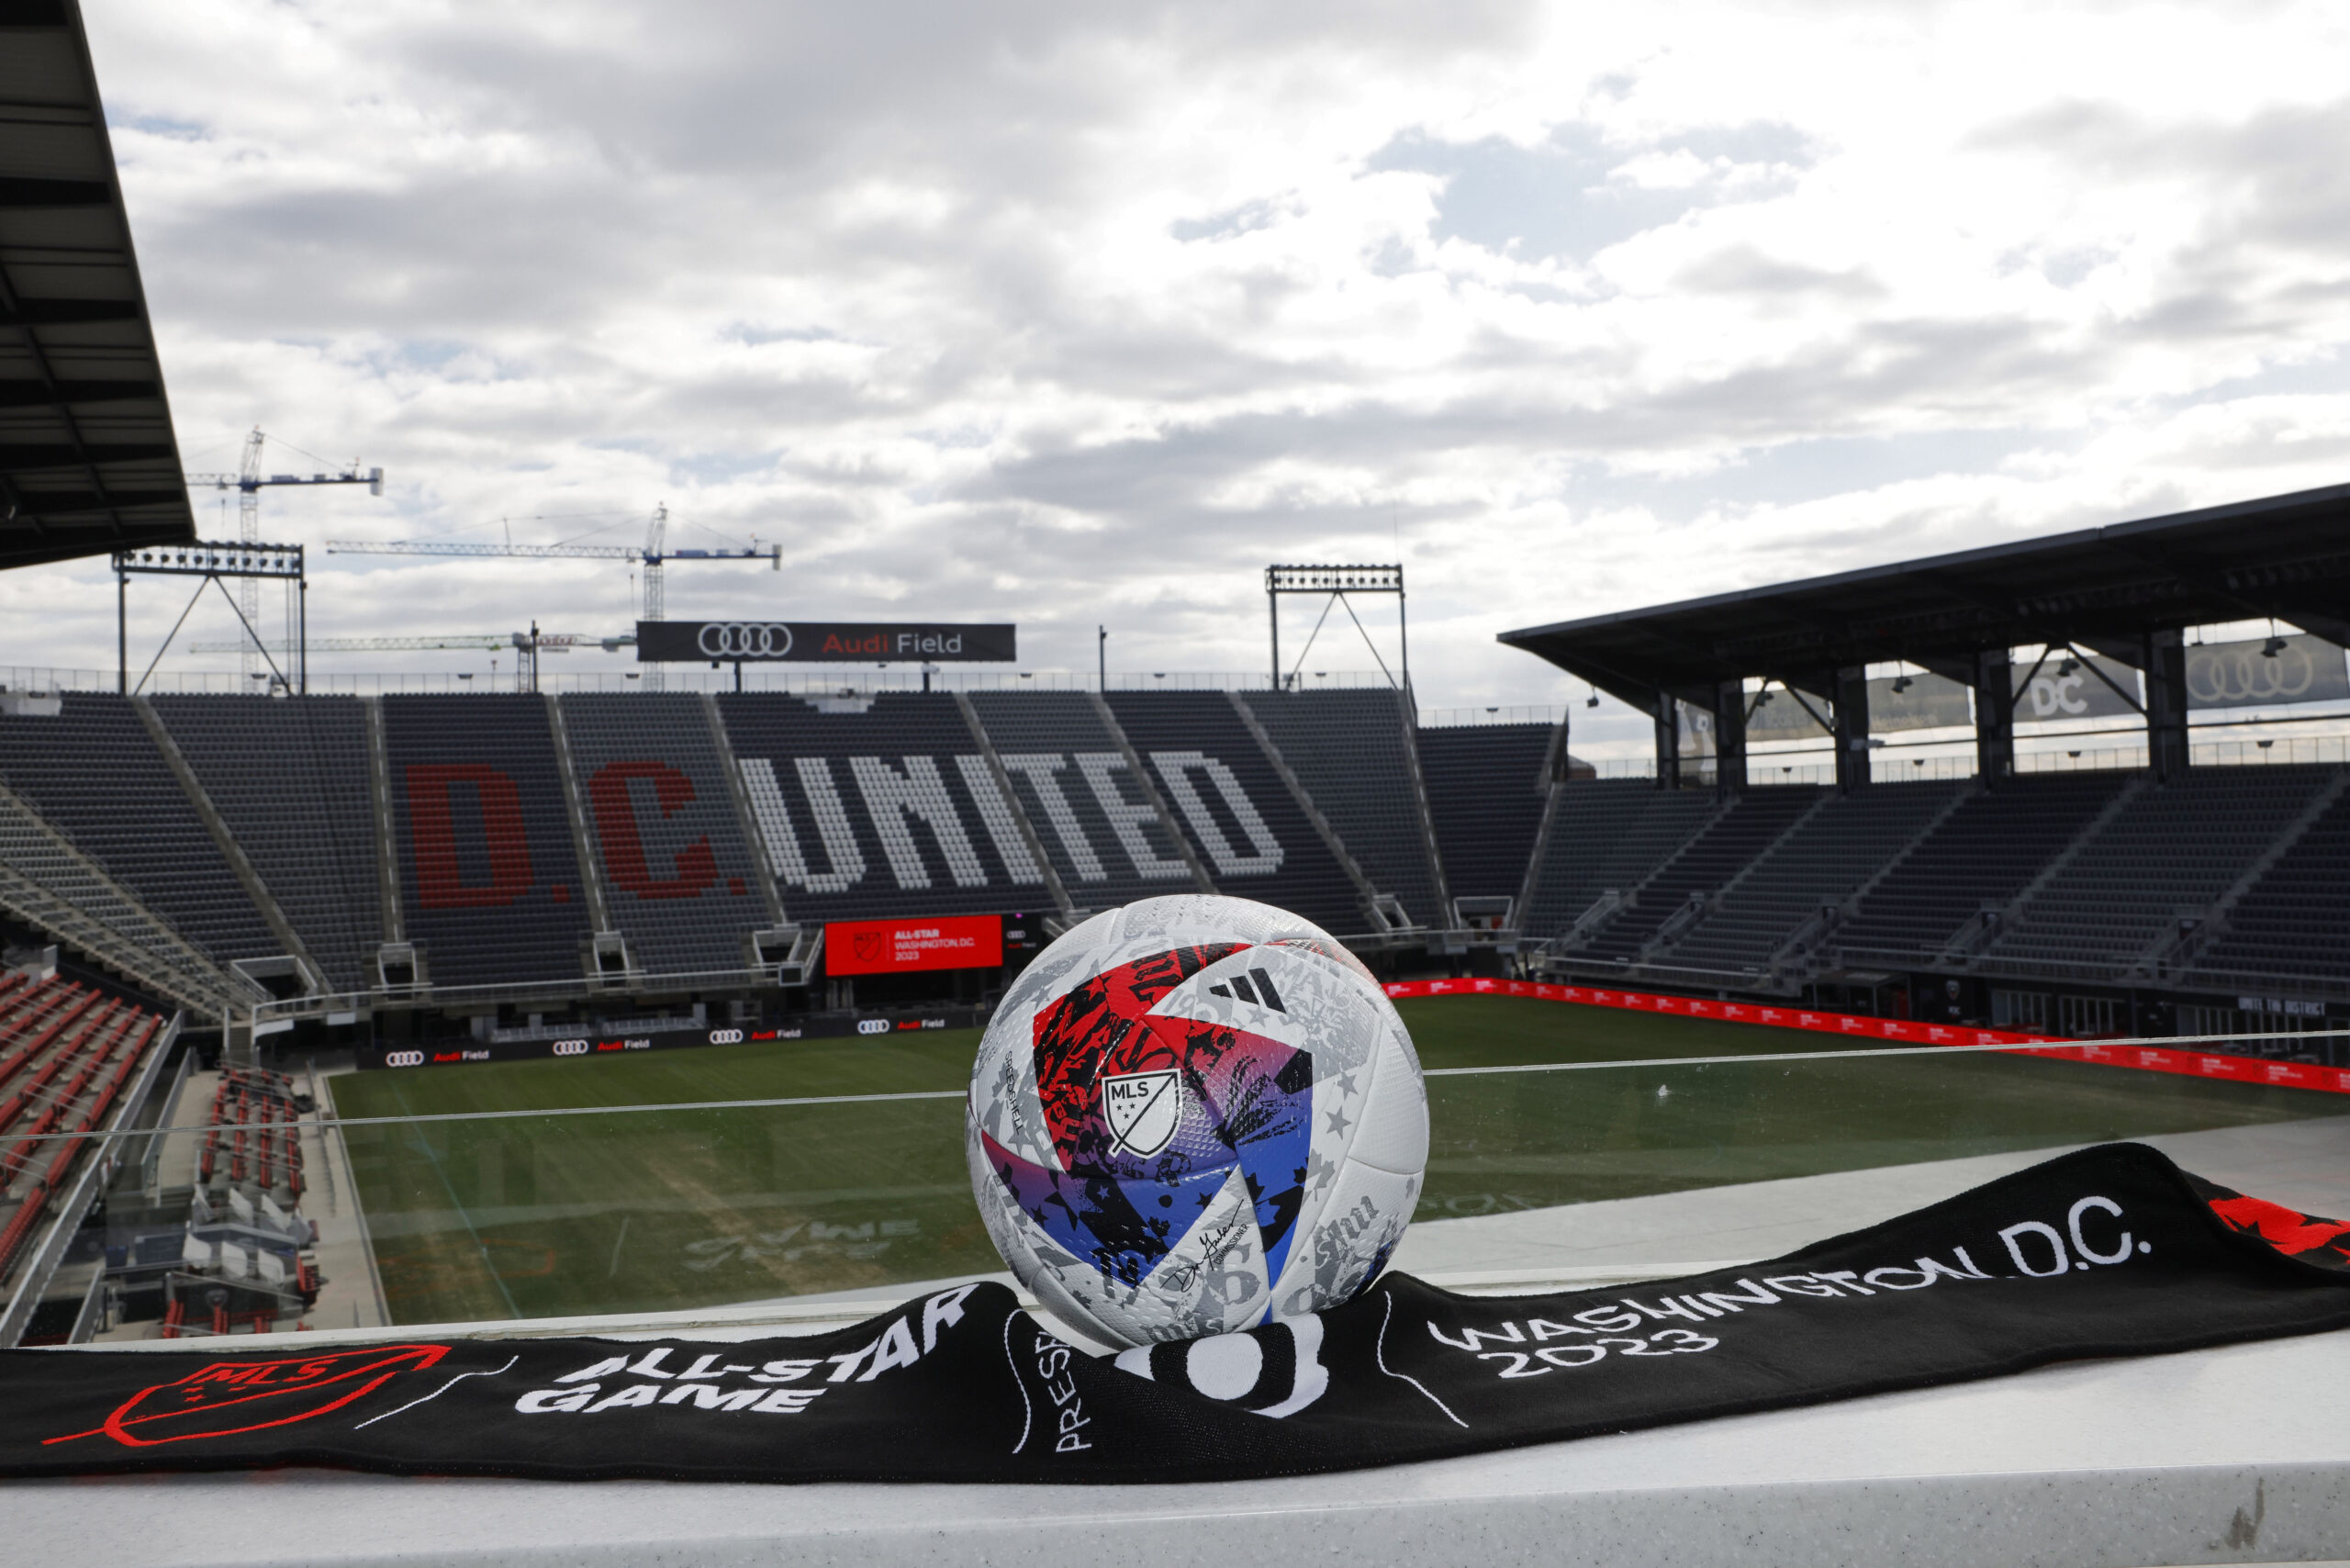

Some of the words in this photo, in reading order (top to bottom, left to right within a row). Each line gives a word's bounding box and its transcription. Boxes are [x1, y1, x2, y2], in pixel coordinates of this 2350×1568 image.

[822, 633, 889, 654] Audi
[897, 633, 962, 654] Field
[738, 751, 1284, 894] UNITED
[894, 929, 940, 940] ALL-STAR
[895, 951, 920, 961] 2023
[751, 1031, 776, 1040] Audi
[777, 1029, 801, 1038] Field
[898, 1020, 921, 1030] Audi
[922, 1019, 945, 1028] Field
[433, 1053, 461, 1062] Audi
[463, 1050, 489, 1060] Field
[597, 1041, 623, 1051] Audi
[624, 1039, 650, 1049] Field
[1004, 1050, 1026, 1136] SPEEDSHELL
[1111, 1081, 1149, 1101] MLS
[1214, 1224, 1250, 1265] COMMISSIONER
[1427, 1246, 1987, 1353] WASHINGTON
[1998, 1195, 2152, 1278] D.C.
[554, 1282, 979, 1383] ALL-STAR
[1476, 1327, 1719, 1379] 2023
[208, 1360, 339, 1383] MLS
[514, 1383, 828, 1415] GAME
